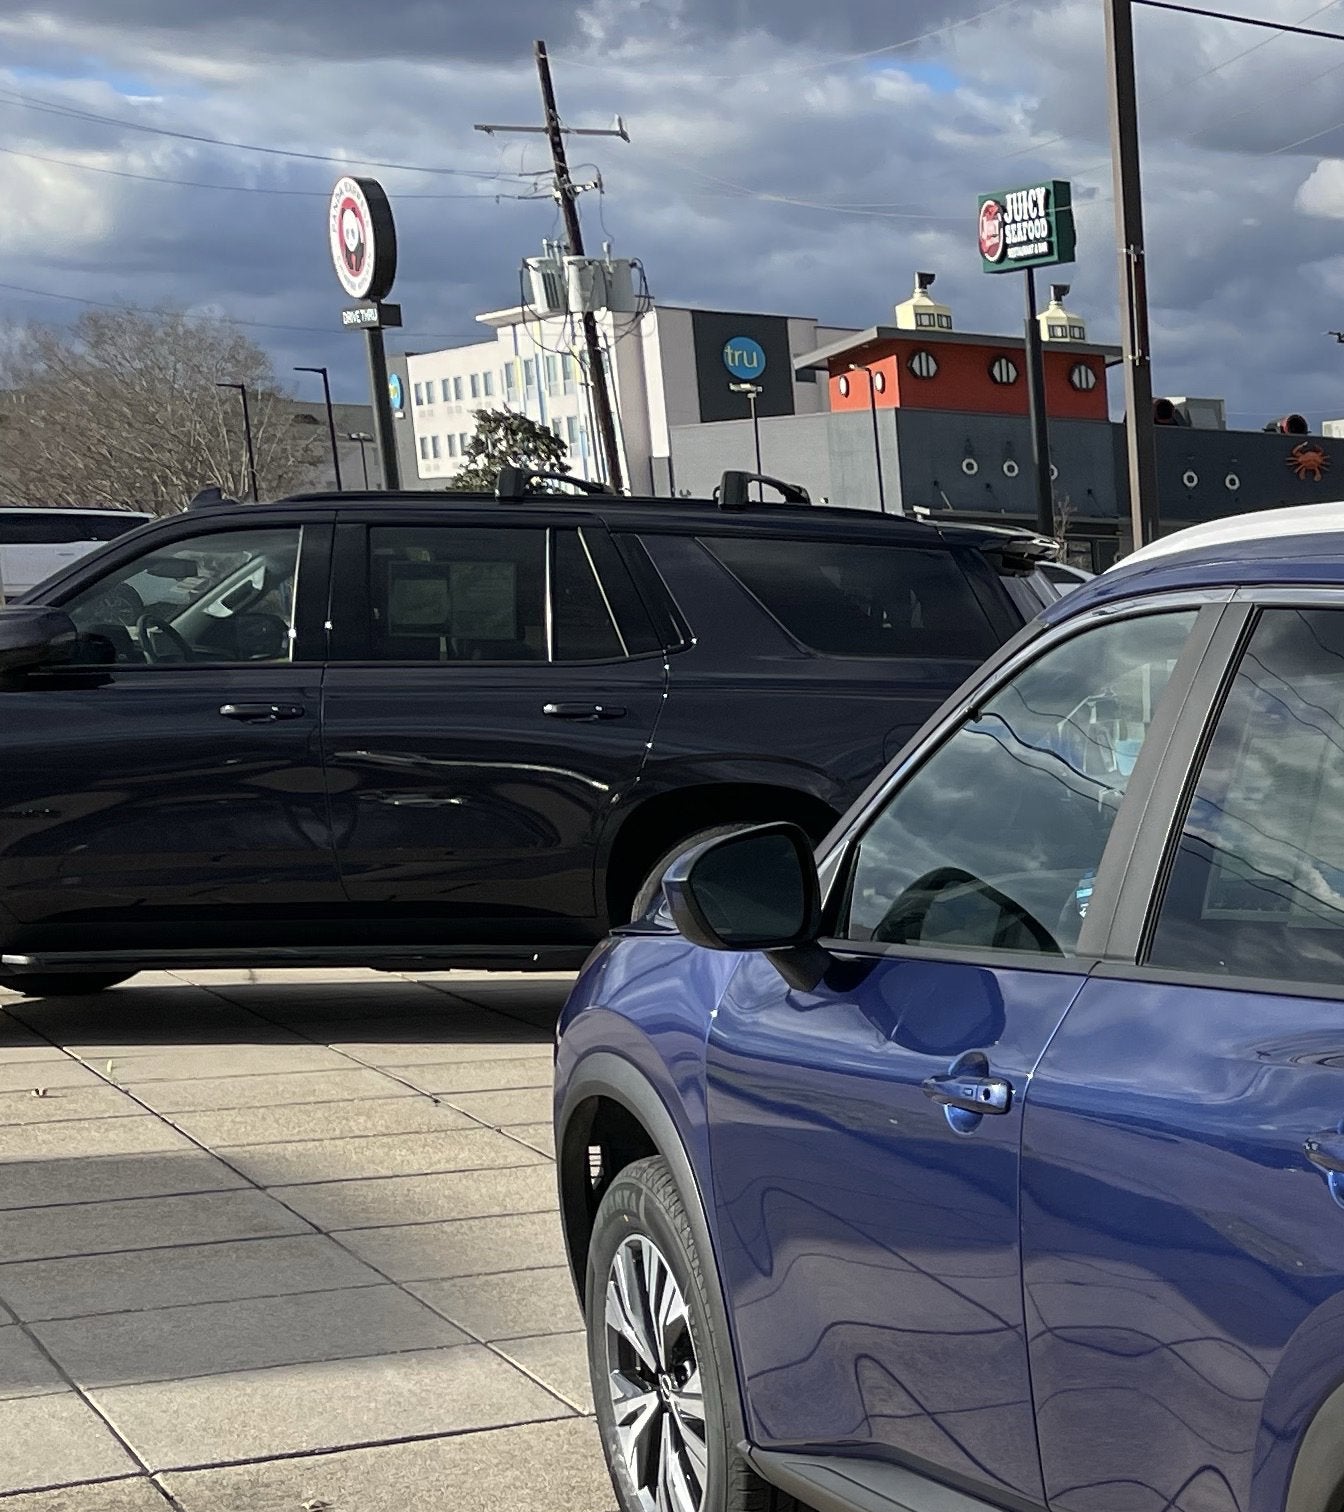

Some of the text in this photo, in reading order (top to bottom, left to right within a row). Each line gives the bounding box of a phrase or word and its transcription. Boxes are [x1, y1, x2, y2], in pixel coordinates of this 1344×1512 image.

[1003, 187, 1046, 224] JUICY
[1004, 218, 1049, 244] SEAFOOD
[342, 308, 378, 325] DRIVE THRU
[724, 345, 758, 368] tru
